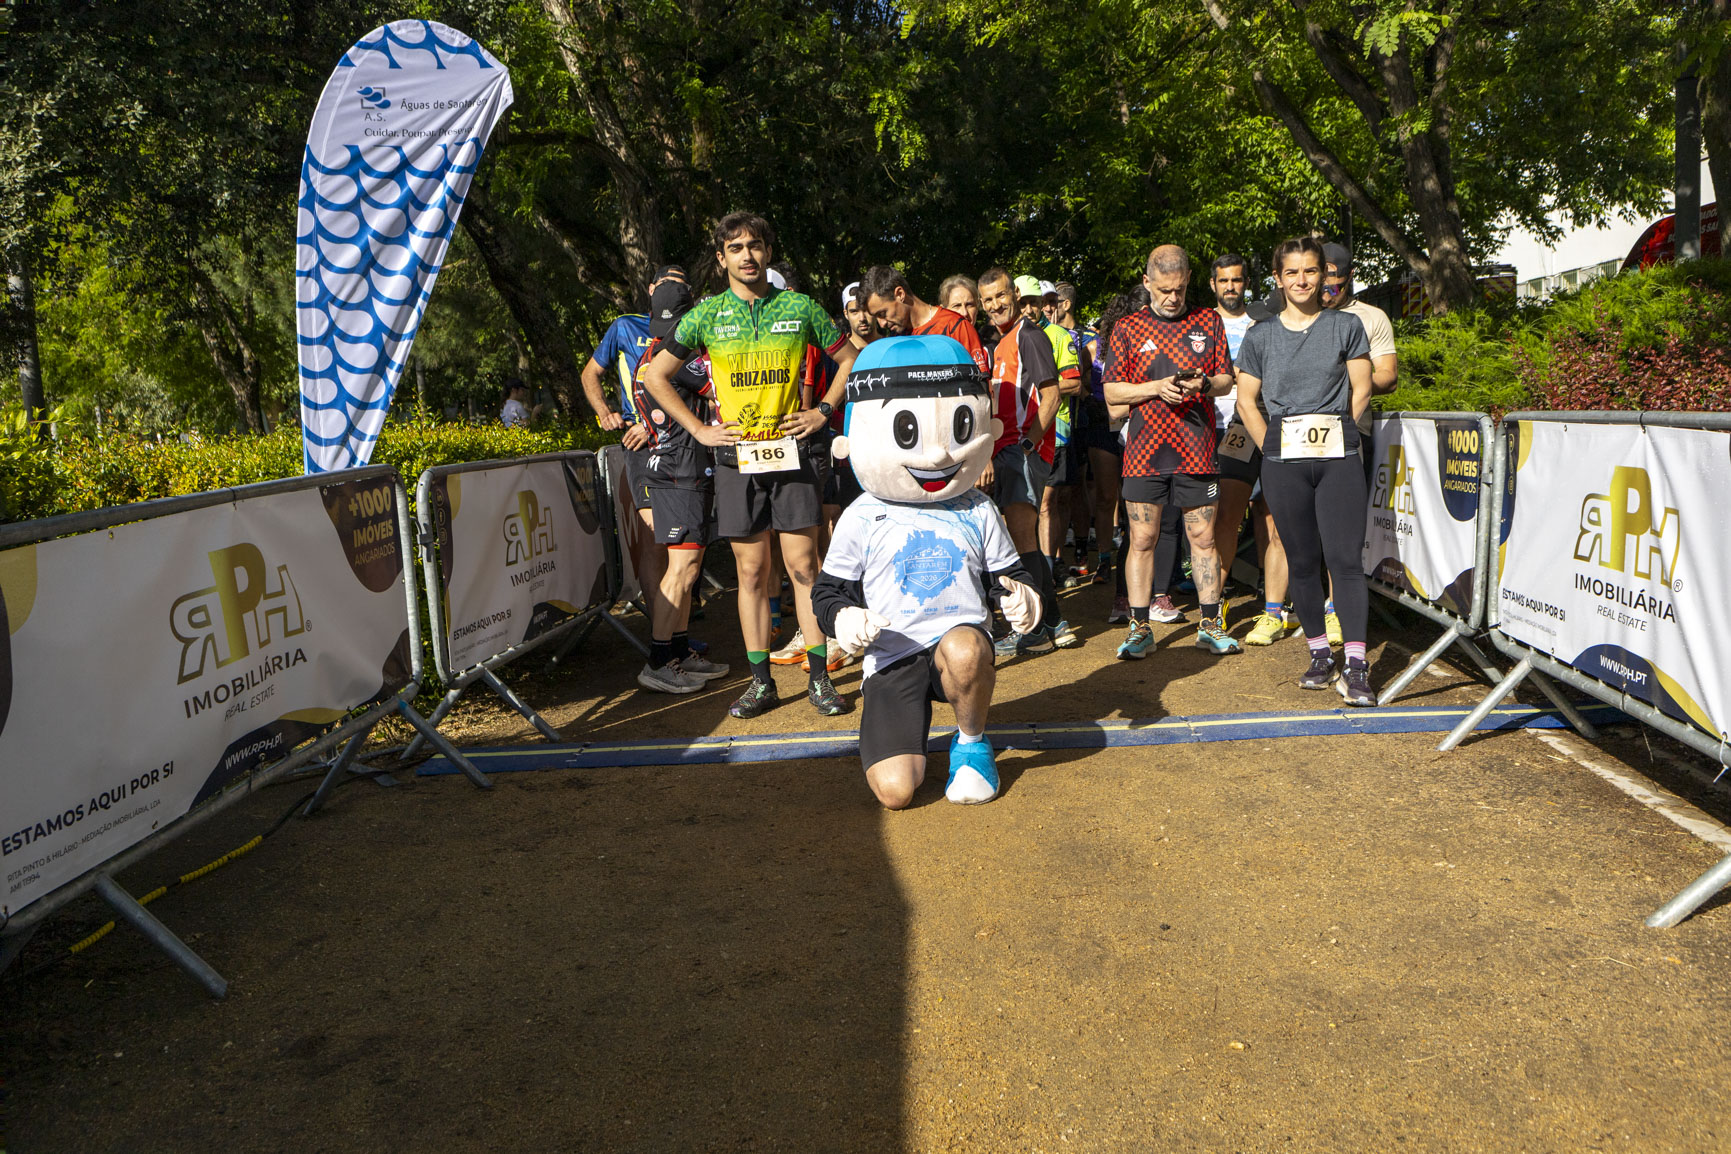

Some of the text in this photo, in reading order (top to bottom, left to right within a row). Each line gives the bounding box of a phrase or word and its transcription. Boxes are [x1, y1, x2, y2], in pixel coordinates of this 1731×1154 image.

[364, 112, 386, 122] A.S.
[401, 98, 430, 111] Águas
[433, 100, 444, 109] de
[727, 349, 791, 372] MUNDOS
[730, 368, 790, 388] CRUZADOS
[750, 447, 785, 462] 186
[1446, 456, 1478, 478] IMÓVEIS
[1444, 479, 1477, 494] ANGARIADOS
[348, 486, 392, 518] +1000
[353, 519, 394, 548] IMÓVEIS
[354, 542, 396, 566] ANGARIADOS
[1525, 598, 1544, 615] AQUI
[1544, 604, 1558, 619] POR
[1559, 609, 1566, 623] SI
[1574, 573, 1676, 624] IMOBILIÁRIA
[453, 608, 512, 641] ESTAMOS AQUI POR SI
[1597, 604, 1648, 632] REAL ESTATE
[184, 647, 308, 719] IMOBILIÁRIA
[224, 684, 275, 722] REAL ESTATE
[225, 732, 283, 771] WWW.RPH.PT
[1, 760, 174, 857] ESTAMOS AQUI POR SI
[7, 869, 23, 883] RITA
[22, 858, 45, 875] PINTO
[46, 855, 52, 864] &
[52, 841, 79, 860] HILÁRIO
[81, 822, 112, 844] MEDIAÇÃO
[150, 799, 161, 810] LDA
[10, 882, 22, 894] AMI
